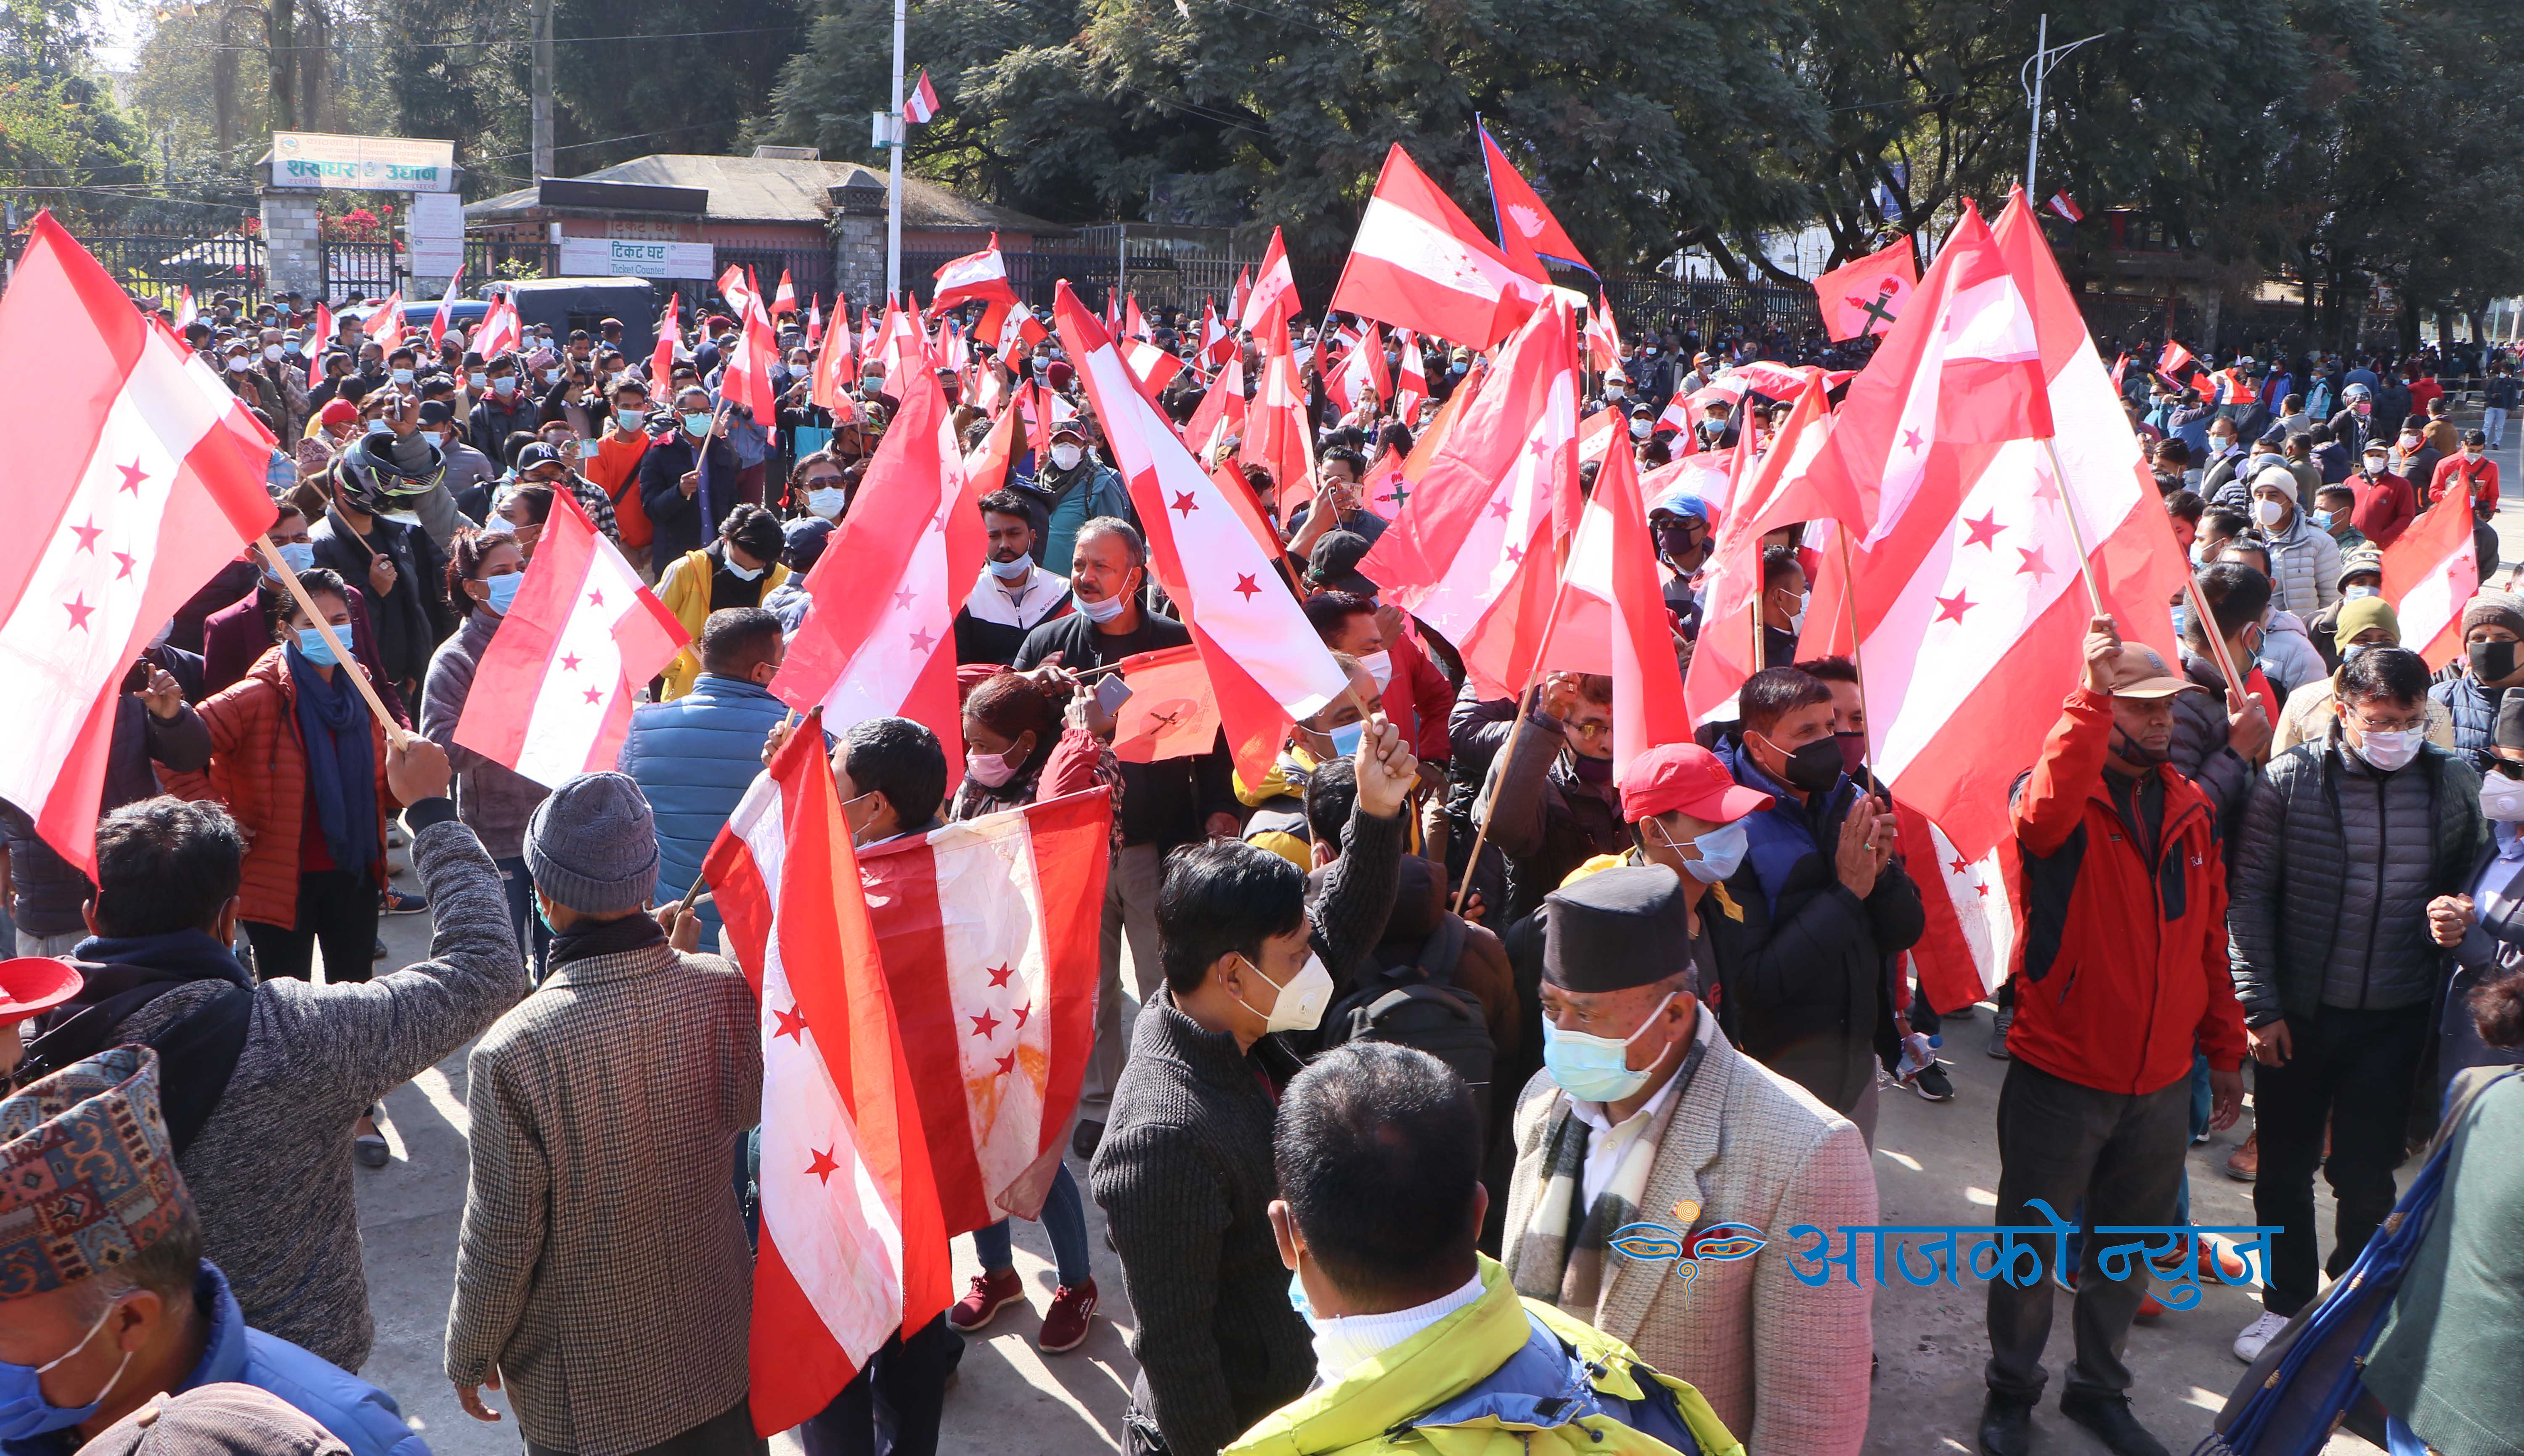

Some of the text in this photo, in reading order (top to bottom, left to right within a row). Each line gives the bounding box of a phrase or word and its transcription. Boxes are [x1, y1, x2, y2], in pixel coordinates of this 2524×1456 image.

[612, 241, 645, 258] टिकट
[647, 246, 665, 259] घर
[611, 264, 665, 275] Ticket Counter
